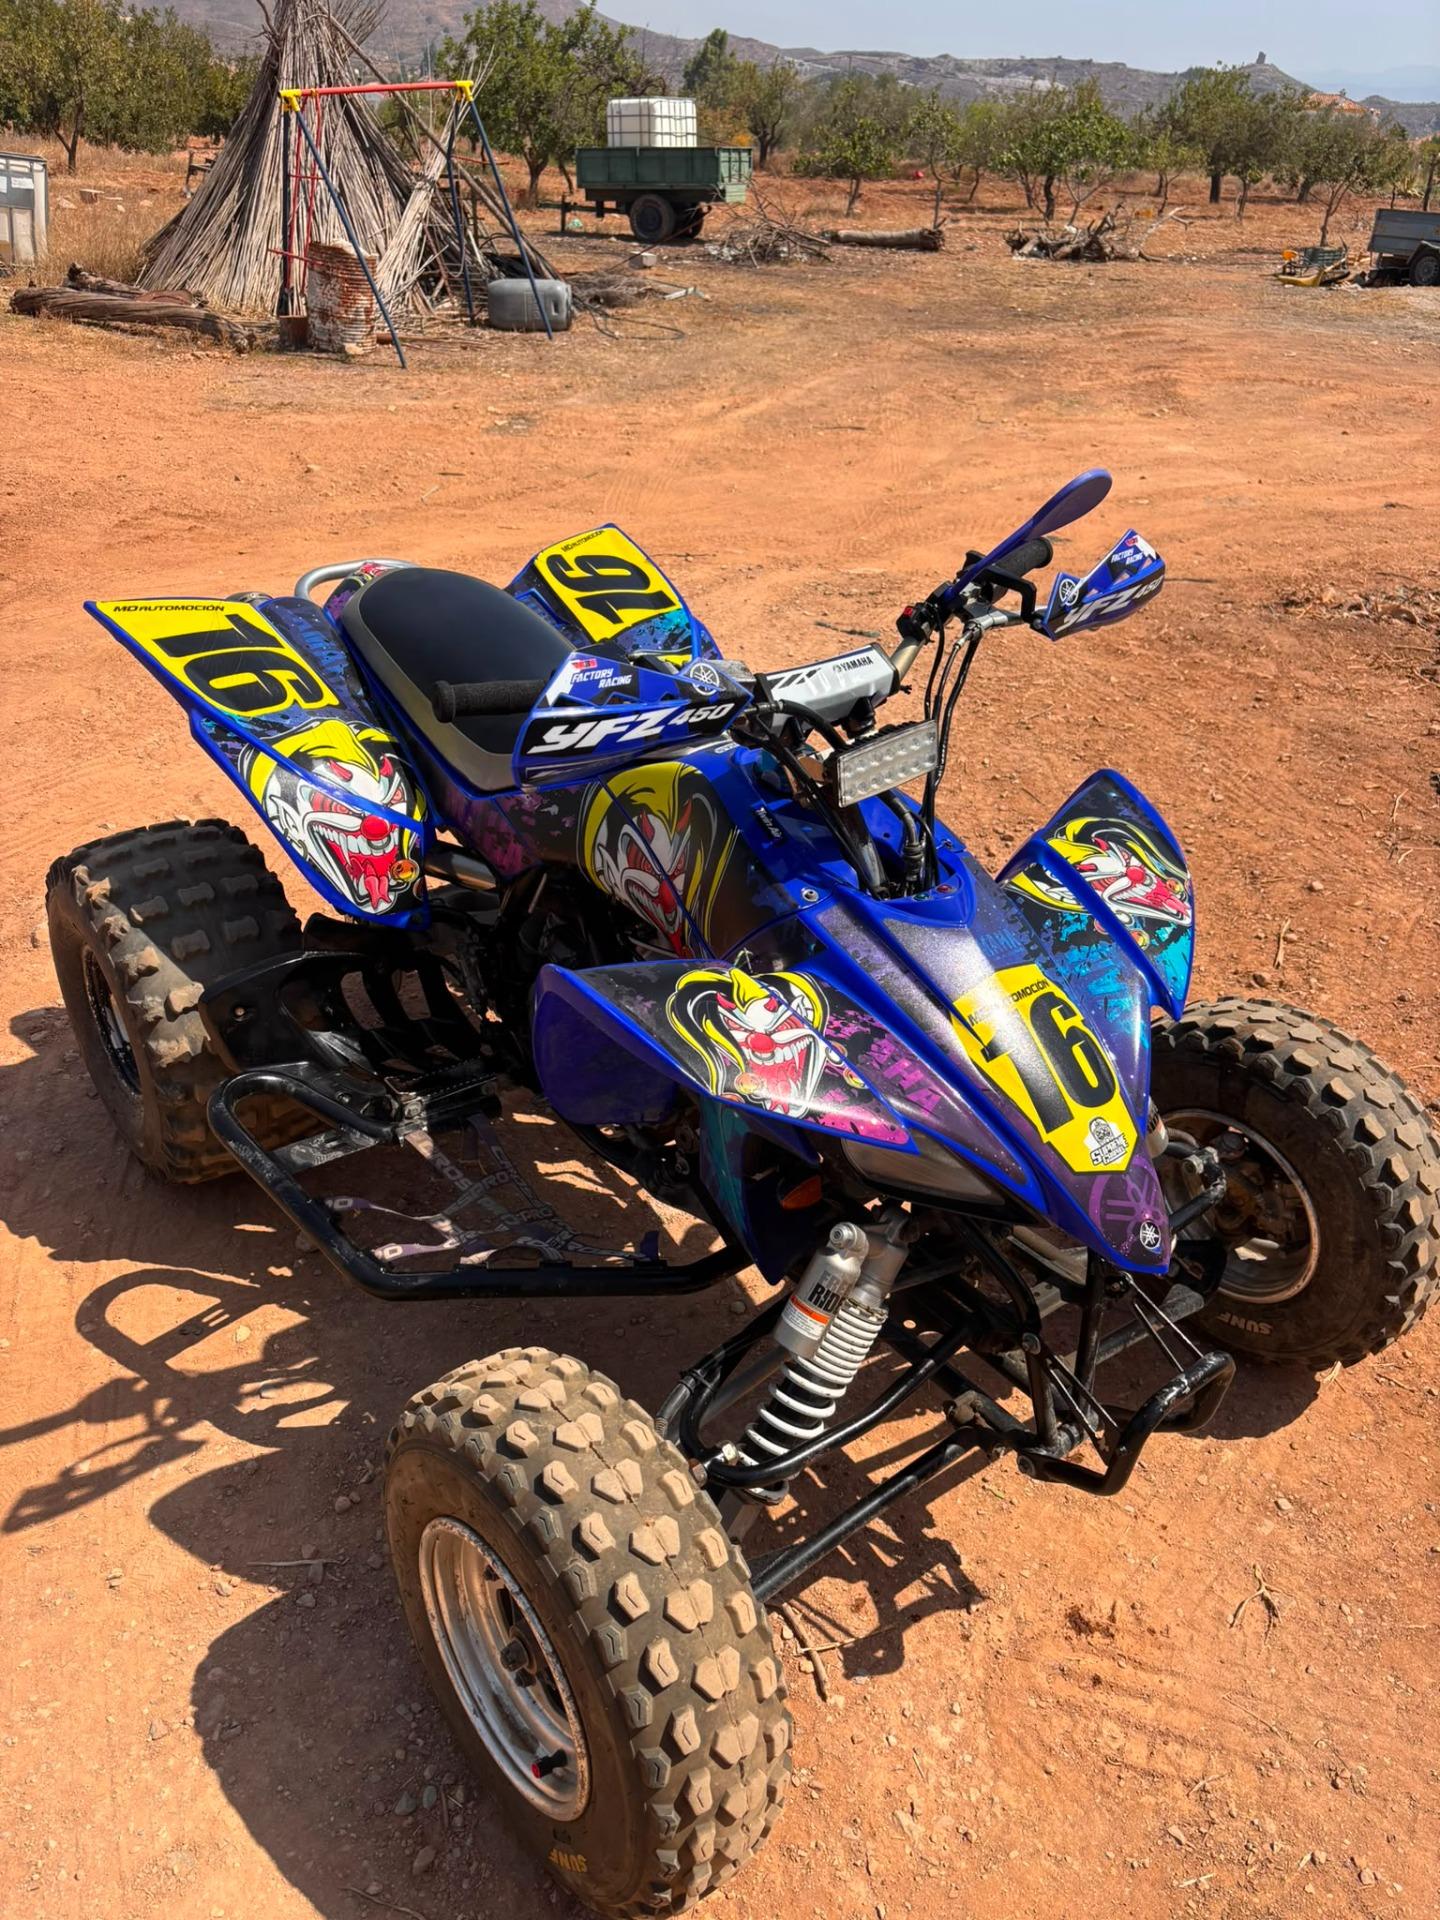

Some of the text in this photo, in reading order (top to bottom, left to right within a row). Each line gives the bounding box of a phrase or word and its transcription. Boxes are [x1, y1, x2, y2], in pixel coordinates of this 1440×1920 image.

[1110, 548, 1134, 563] FACTORY
[152, 613, 323, 713] 16
[841, 656, 874, 671] YAMAHA
[571, 668, 614, 683] FACTORY
[598, 675, 632, 688] RACING
[526, 703, 735, 754] YFZ 450
[980, 990, 1117, 1134] 16
